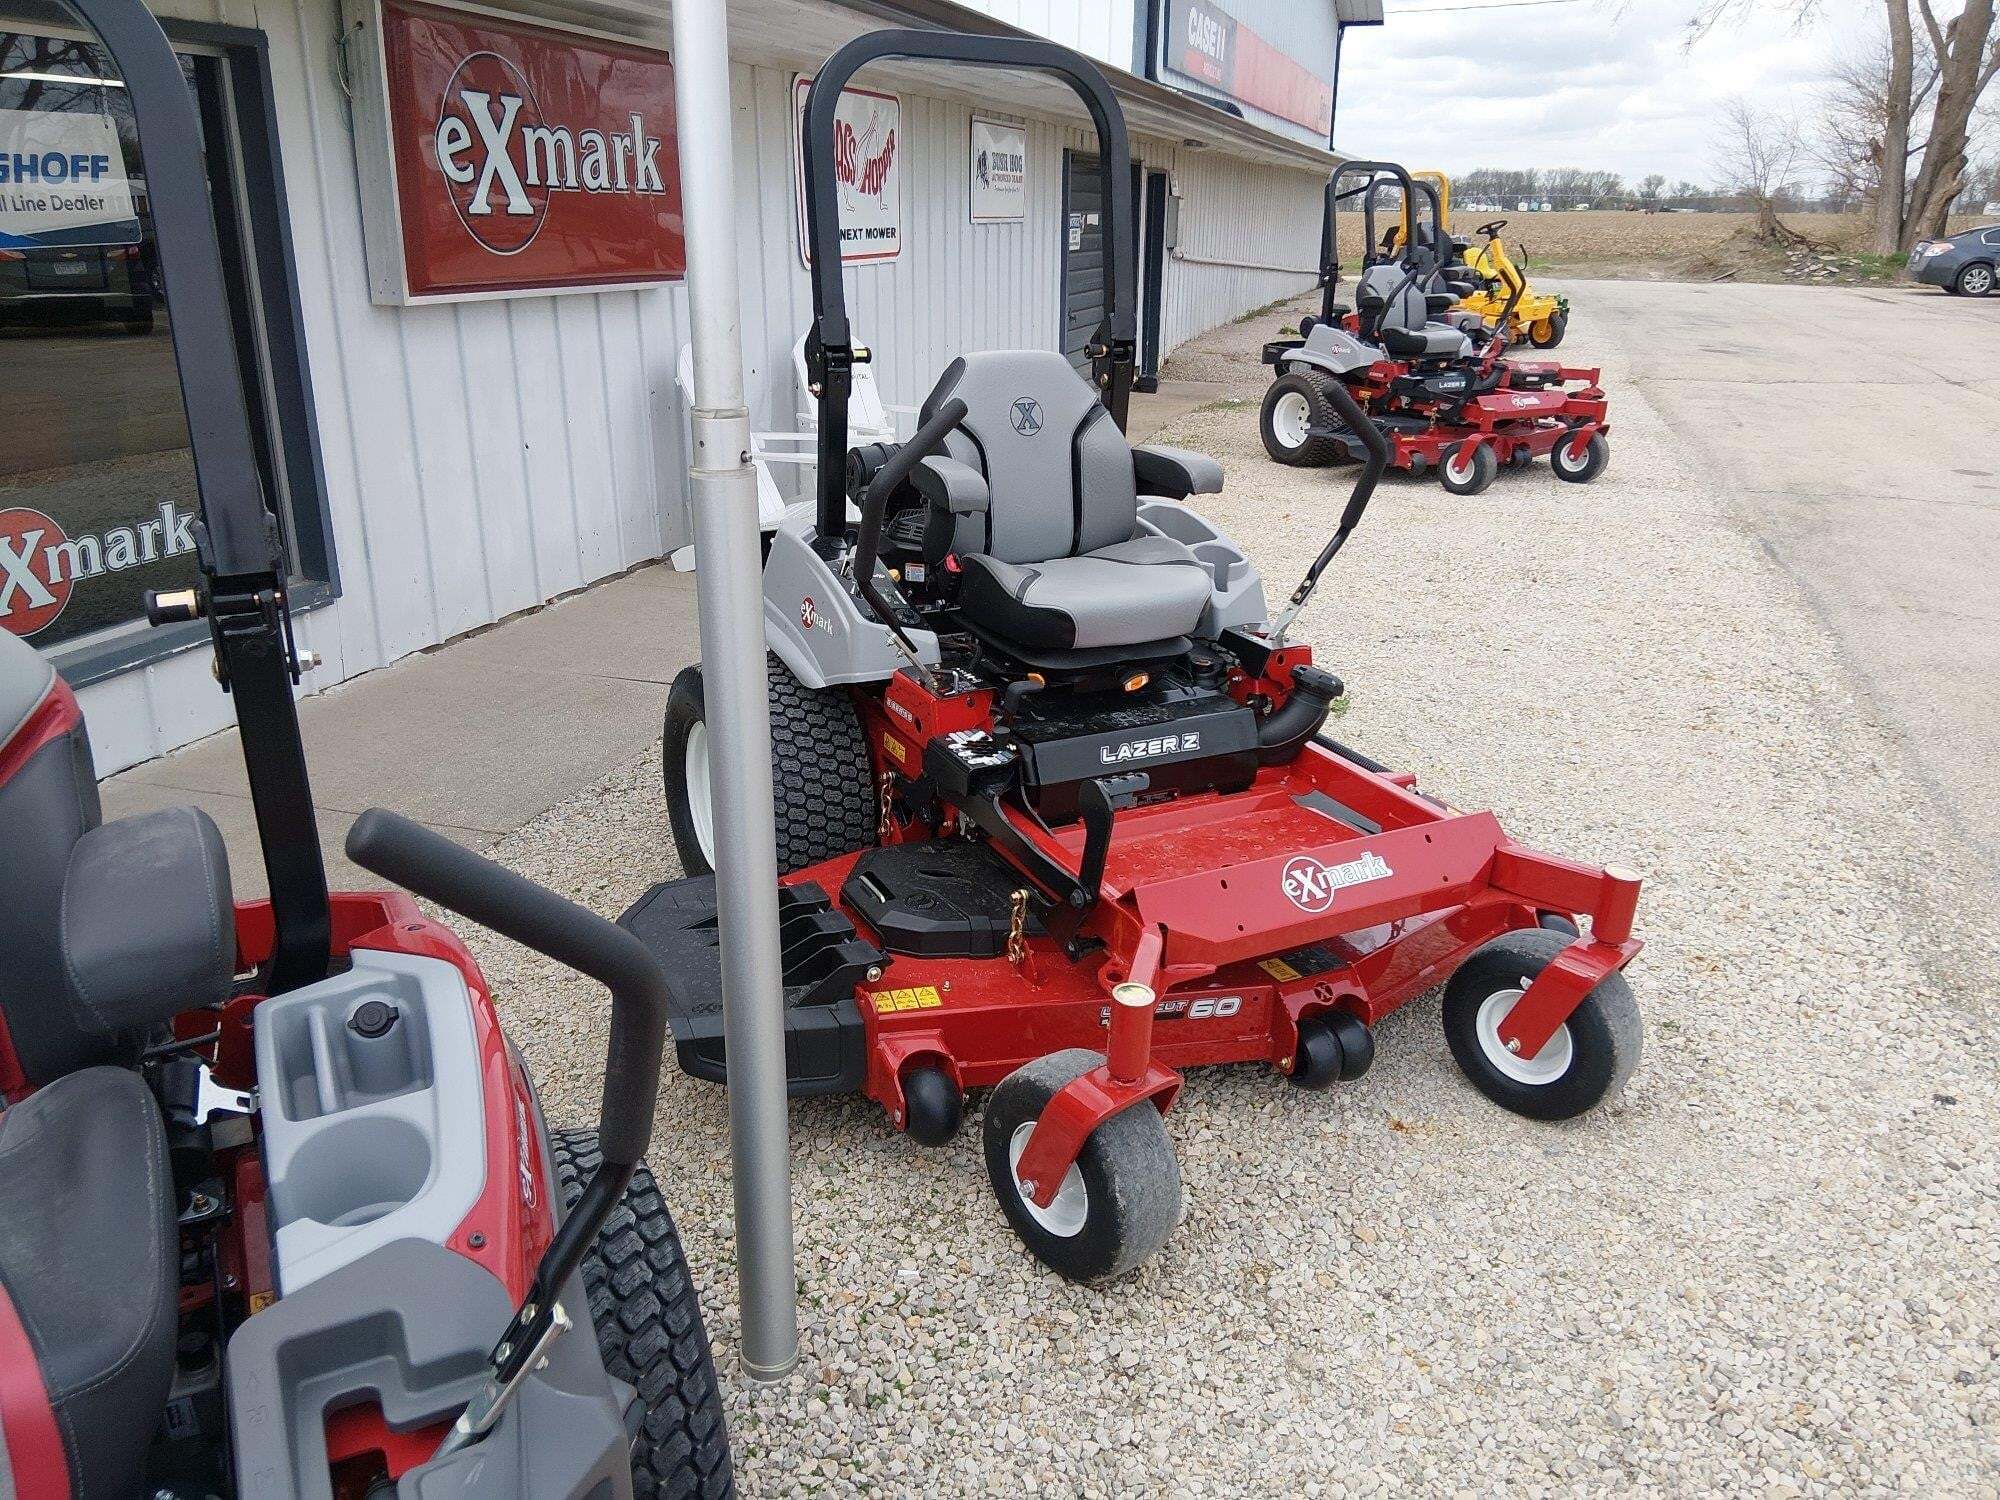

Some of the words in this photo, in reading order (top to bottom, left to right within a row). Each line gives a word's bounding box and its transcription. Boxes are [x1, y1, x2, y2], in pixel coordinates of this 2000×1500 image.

[436, 90, 667, 216] eXmark
[1010, 154, 1023, 174] HOG
[13, 195, 47, 212] Line
[51, 195, 105, 212] Dealer
[840, 229, 863, 241] NEXT
[865, 228, 896, 239] MOWER
[0, 501, 198, 617] Xmark
[1101, 736, 1180, 764] LAZER
[1182, 732, 1200, 751] Z
[1283, 852, 1393, 904] eXmark
[1188, 995, 1242, 1019] 60
